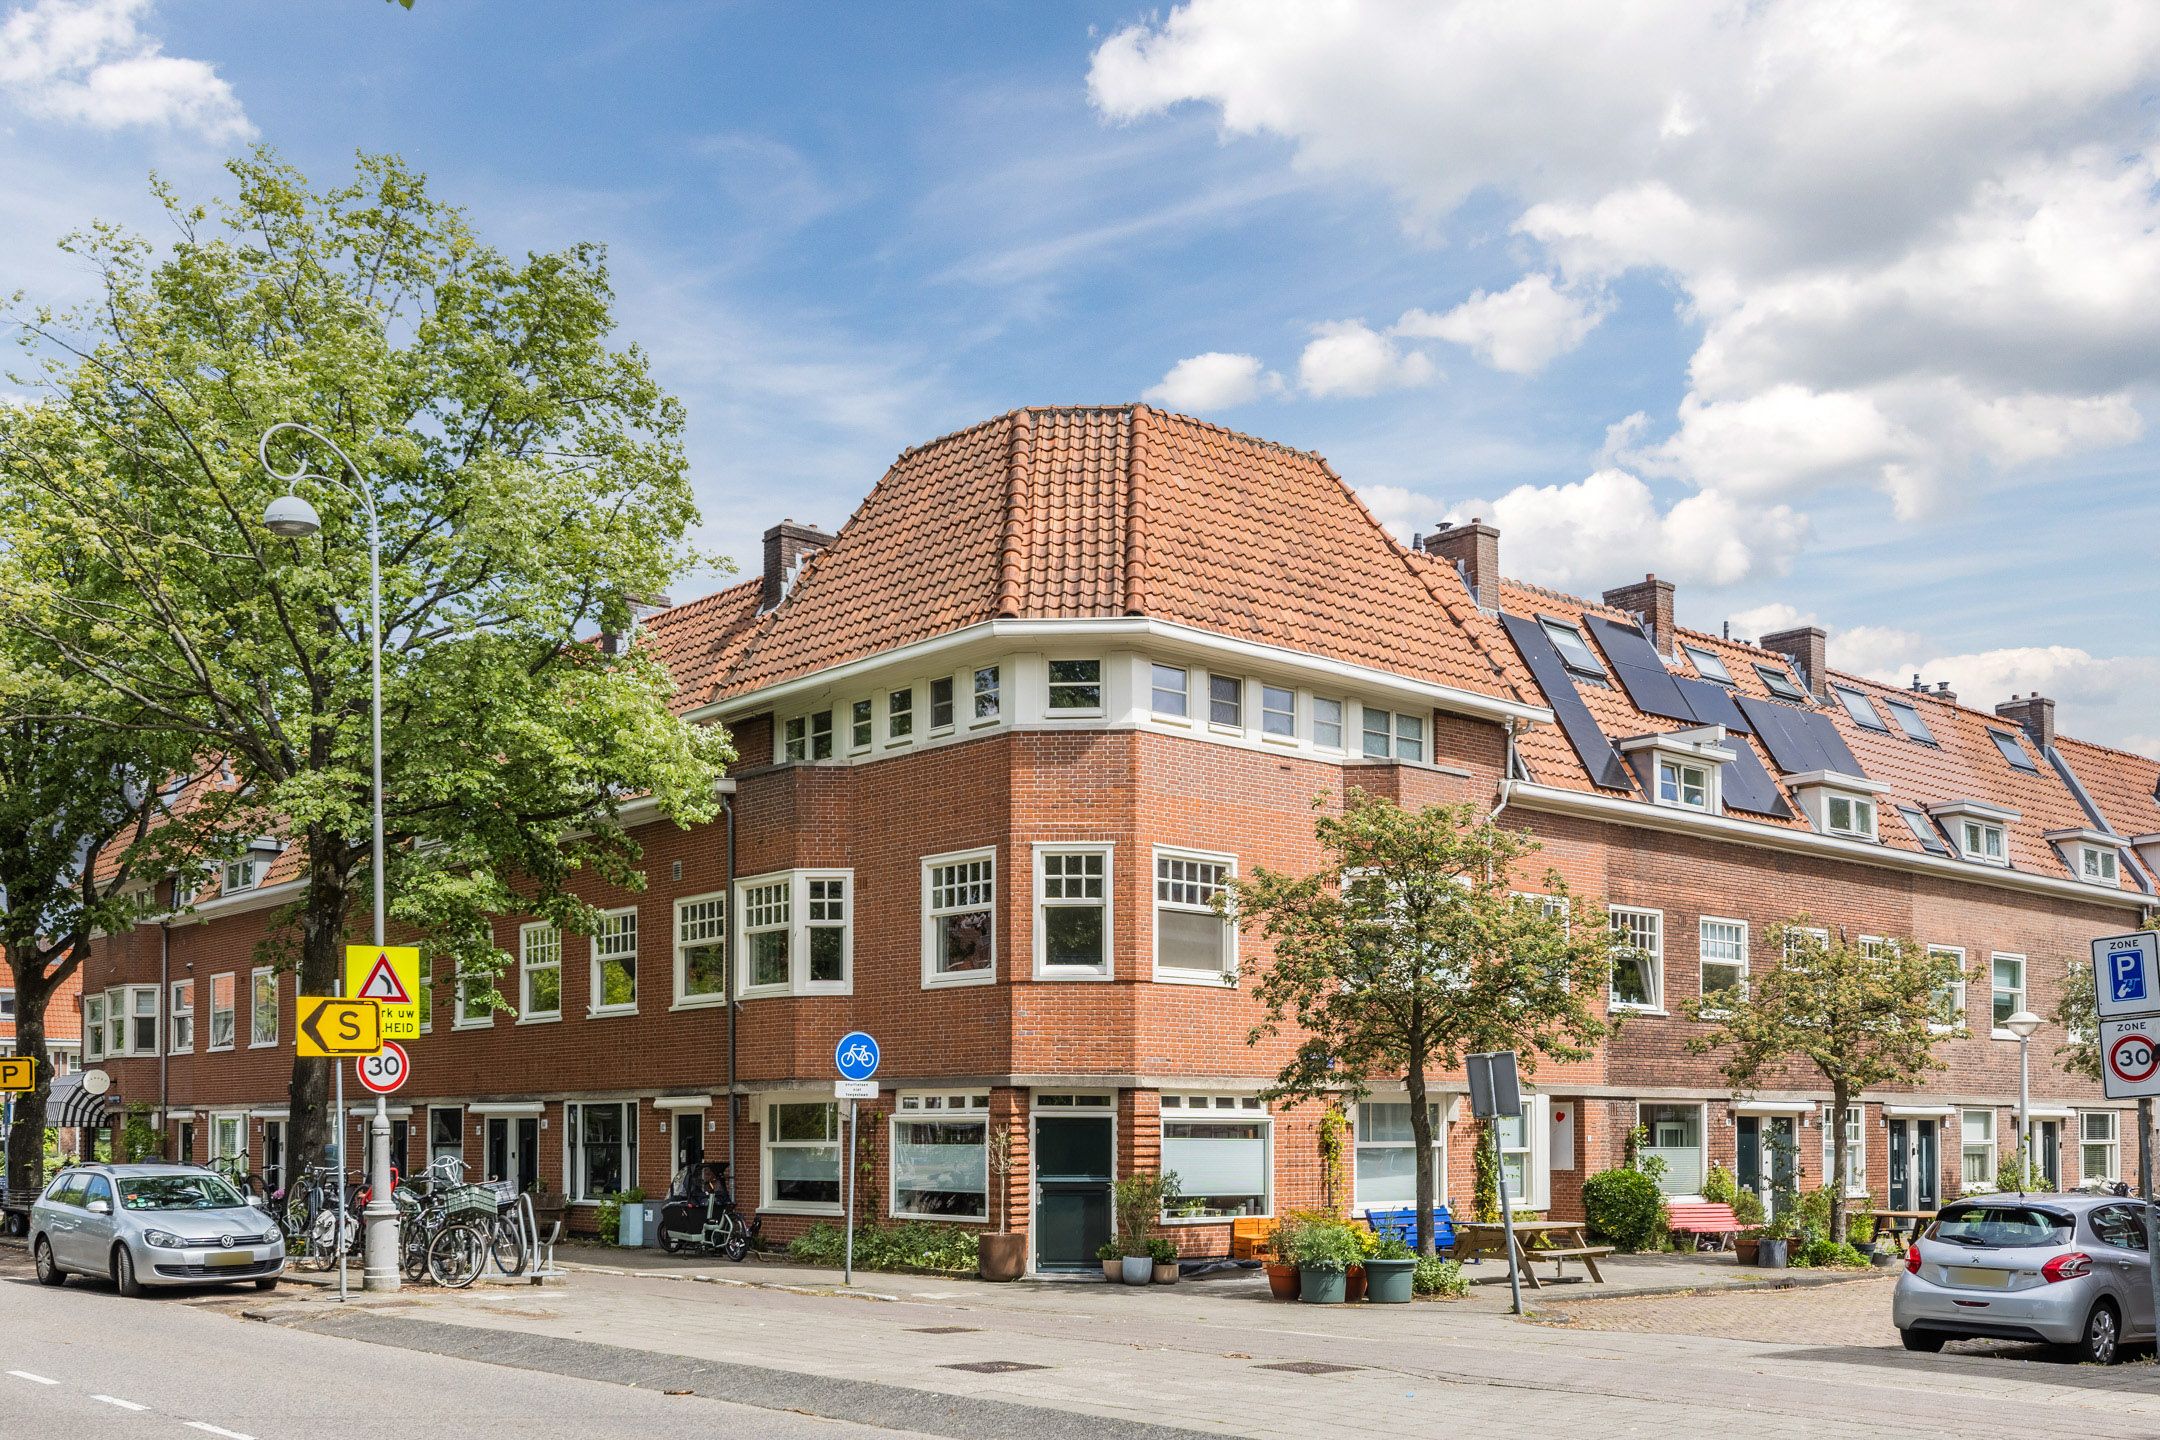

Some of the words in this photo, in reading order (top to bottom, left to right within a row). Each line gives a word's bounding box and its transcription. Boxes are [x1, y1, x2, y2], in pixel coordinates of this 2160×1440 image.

[2109, 939, 2139, 950] ZONE
[2116, 956, 2135, 981] P
[398, 1010, 415, 1018] uw
[338, 1010, 361, 1041] S
[382, 1022, 414, 1033] HEID
[2117, 1022, 2147, 1032] ZONE
[368, 1056, 400, 1077] 30
[2119, 1048, 2150, 1067] 30
[2, 1065, 19, 1084] P
